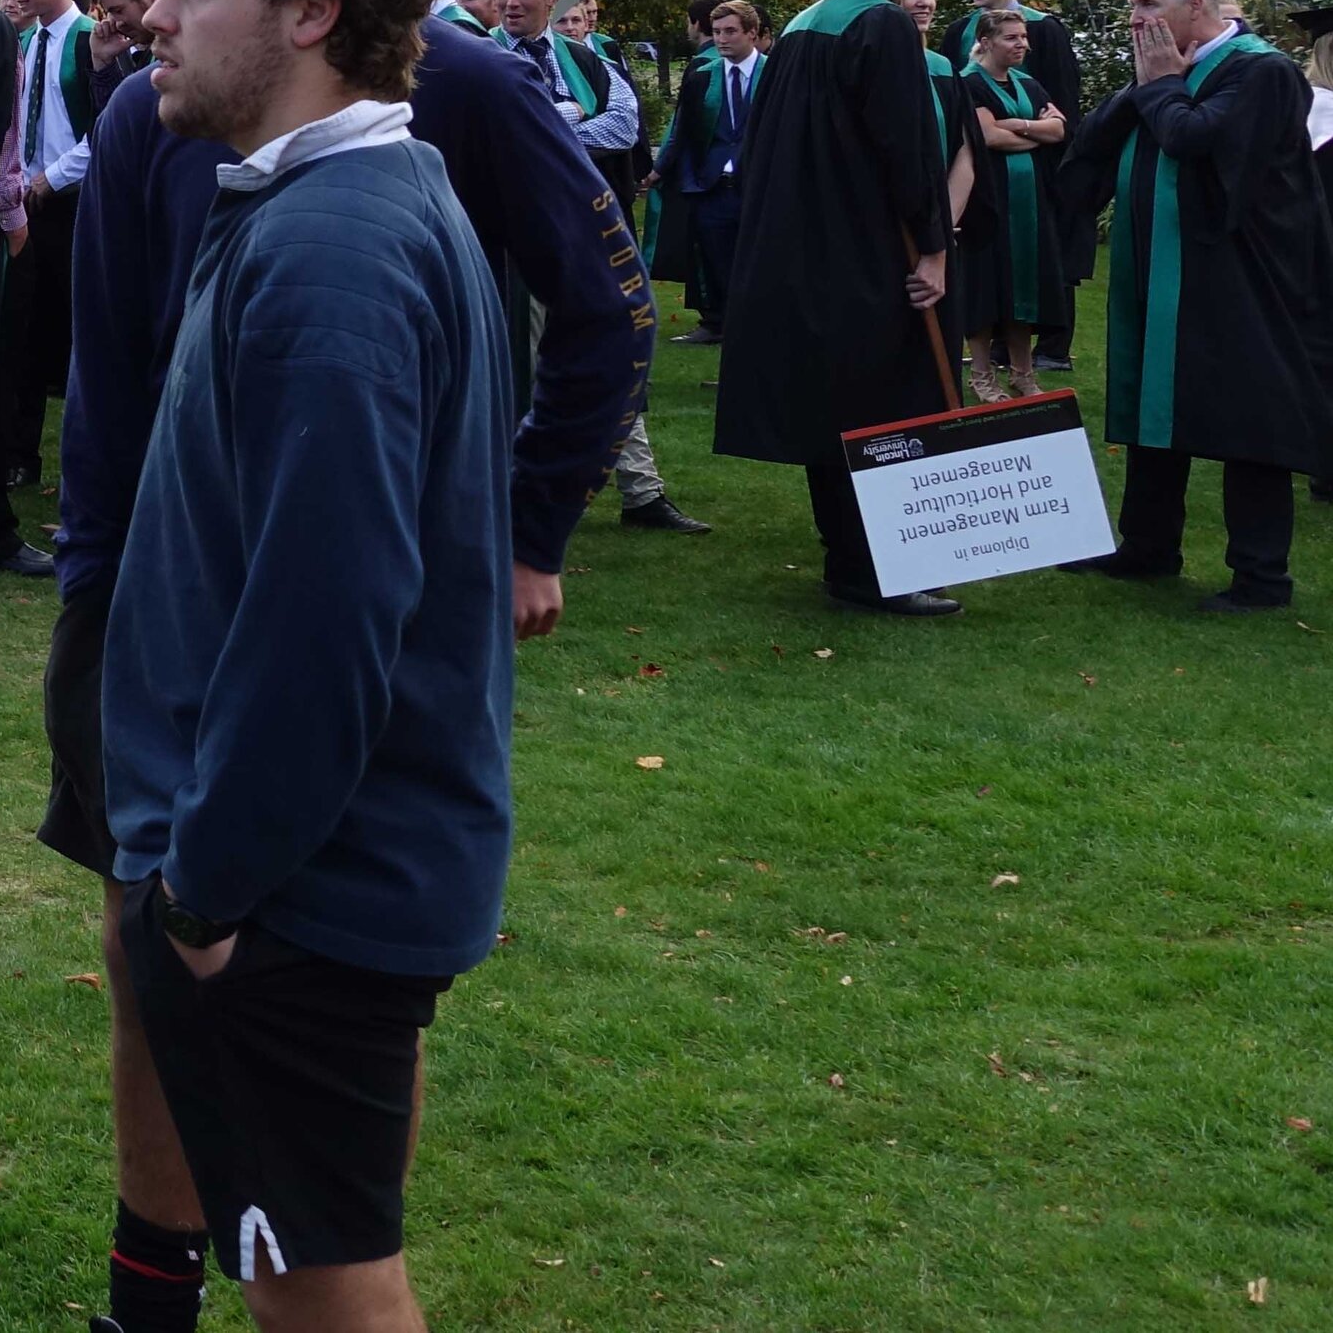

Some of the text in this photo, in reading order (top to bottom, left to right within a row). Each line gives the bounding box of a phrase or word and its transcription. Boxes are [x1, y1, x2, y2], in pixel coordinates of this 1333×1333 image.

[592, 190, 655, 332] STORM
[862, 439, 908, 456] University
[875, 447, 910, 463] Lincoln
[910, 454, 1032, 492] Management
[903, 475, 1053, 516] and Horticulture
[898, 497, 1070, 544] Farm Management
[953, 536, 1030, 562] Diploma in
